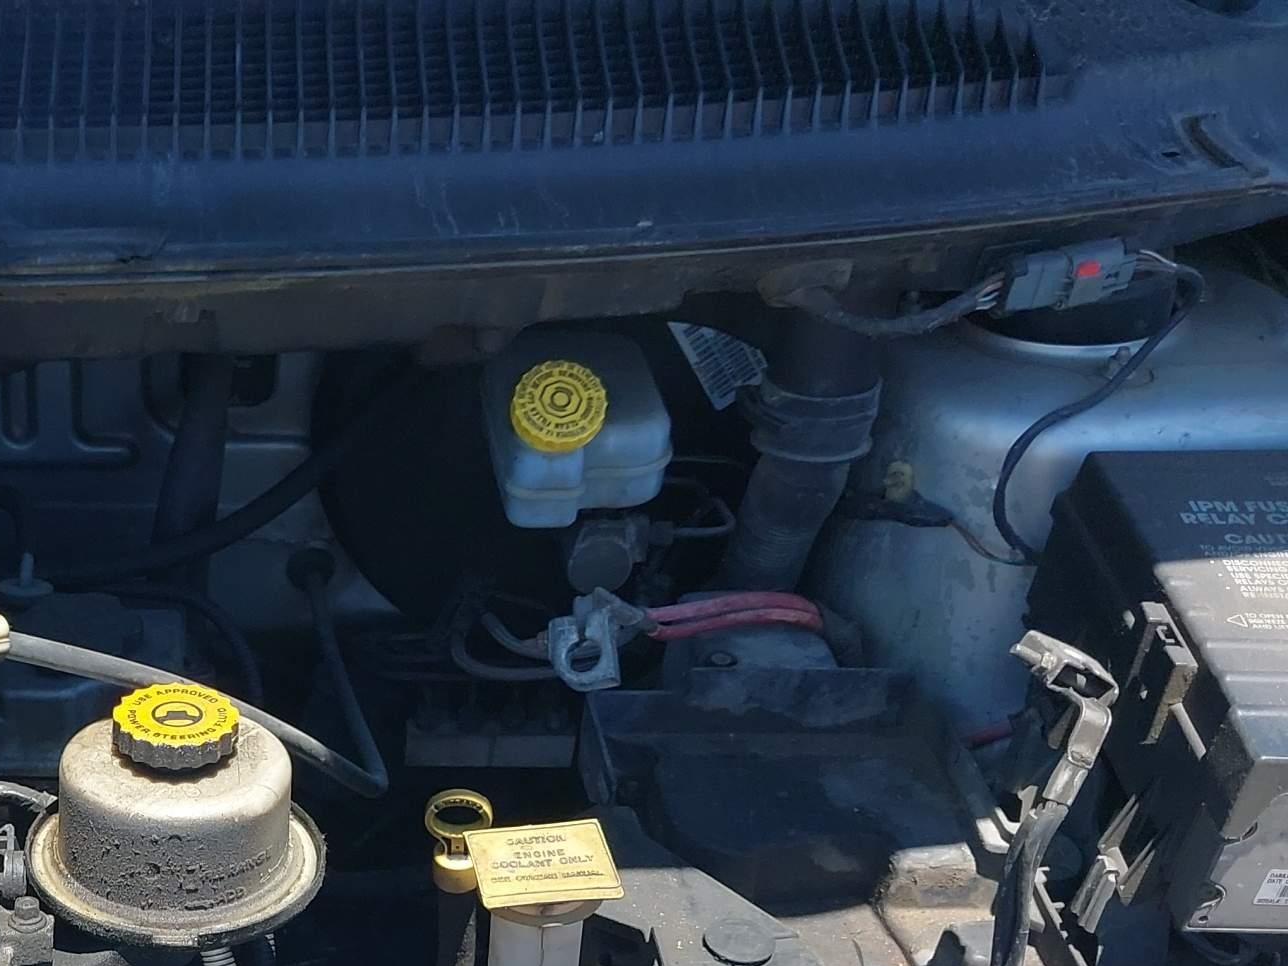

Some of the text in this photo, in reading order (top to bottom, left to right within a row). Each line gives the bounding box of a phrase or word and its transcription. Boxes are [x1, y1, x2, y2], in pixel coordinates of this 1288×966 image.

[1188, 500, 1239, 513] IPM
[1180, 512, 1256, 526] RELAY
[132, 688, 219, 706] USE APPROVED
[127, 707, 228, 741] POWER STEERING FLUID
[506, 834, 567, 846] CAUTION
[513, 848, 566, 859] ENGINE
[491, 855, 595, 870] COOLANT ONLY
